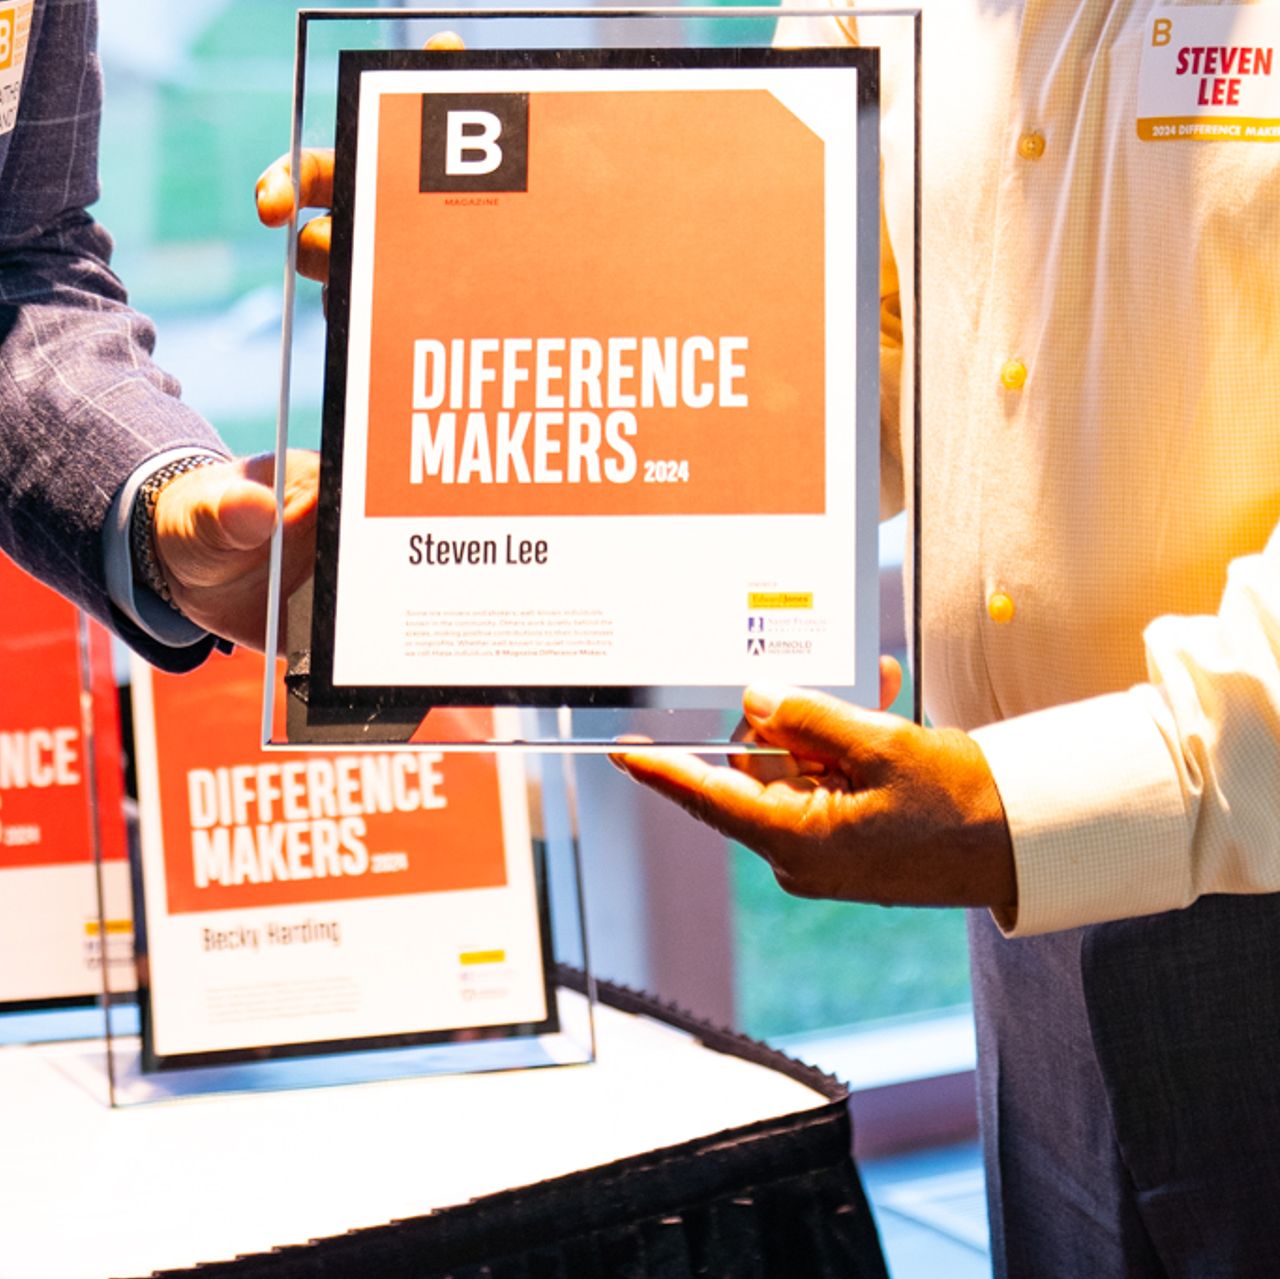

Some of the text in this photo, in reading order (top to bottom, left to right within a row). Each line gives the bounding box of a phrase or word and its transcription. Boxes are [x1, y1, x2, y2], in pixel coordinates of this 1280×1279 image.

[1152, 18, 1172, 47] B
[1176, 46, 1274, 76] STEVEN
[1196, 78, 1242, 106] LEE
[445, 109, 503, 175] B
[1179, 124, 1241, 136] DIFFERENCE
[444, 198, 499, 206] MAGAZINE
[412, 336, 749, 410] DIFFERENCE
[410, 411, 690, 485] MAKERS 2024
[408, 533, 548, 565] Steven Lee
[187, 751, 447, 829] DIFFERENCE
[191, 815, 369, 889] MAKERS
[202, 919, 342, 954] Becky Harding
